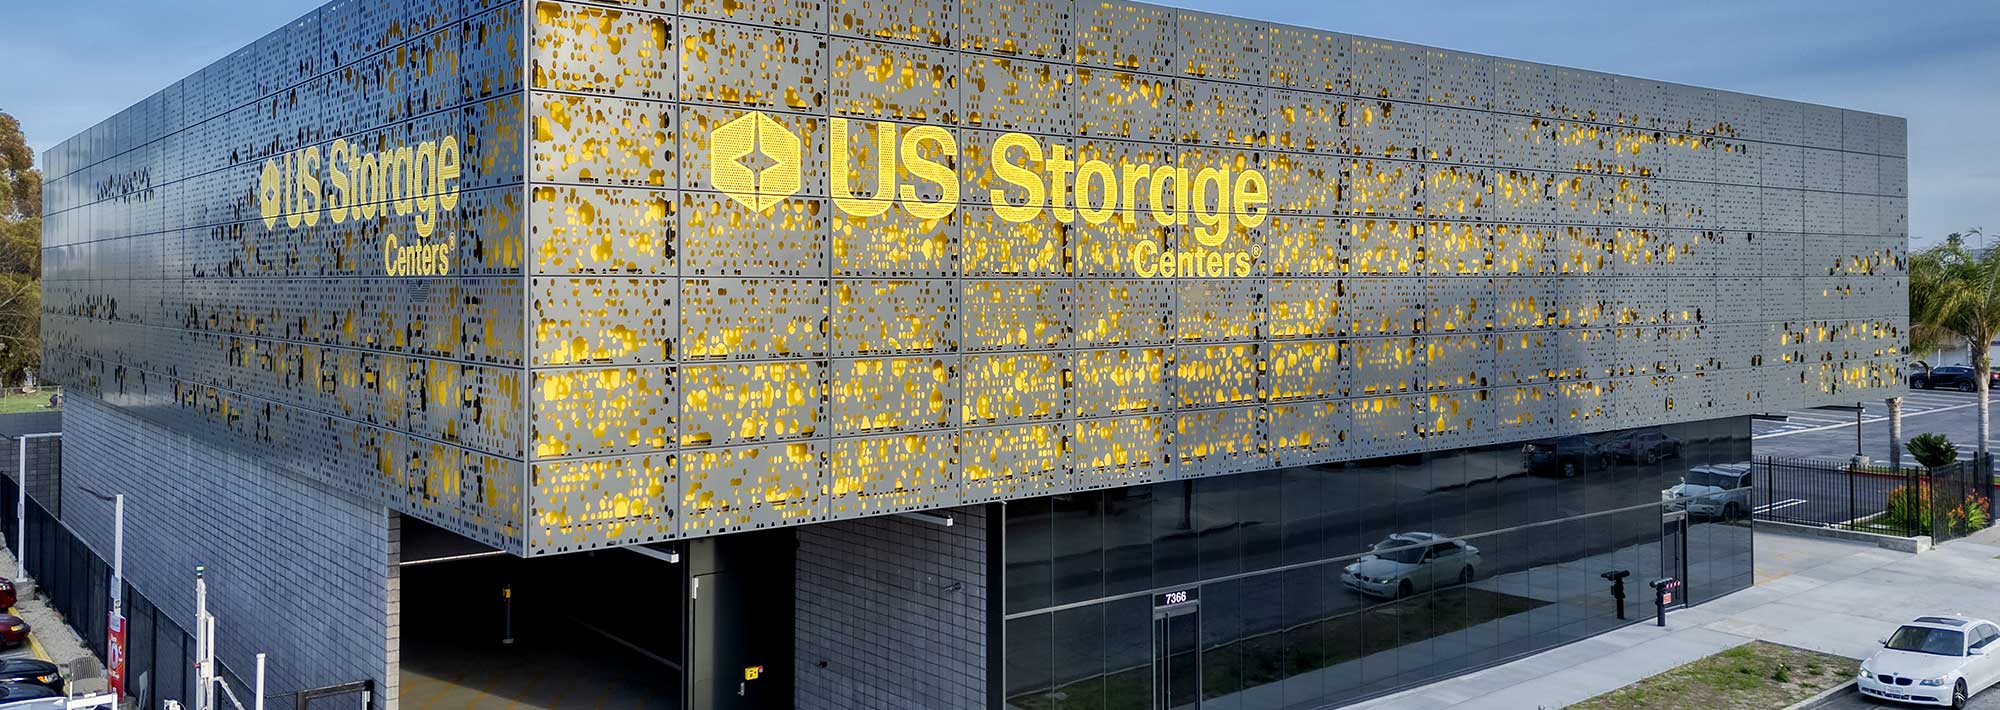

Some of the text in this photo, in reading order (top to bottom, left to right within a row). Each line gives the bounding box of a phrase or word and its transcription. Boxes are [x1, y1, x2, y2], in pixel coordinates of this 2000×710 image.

[285, 135, 460, 238] US Storage
[830, 116, 1268, 247] US Storage
[1165, 591, 1187, 605] 7366
